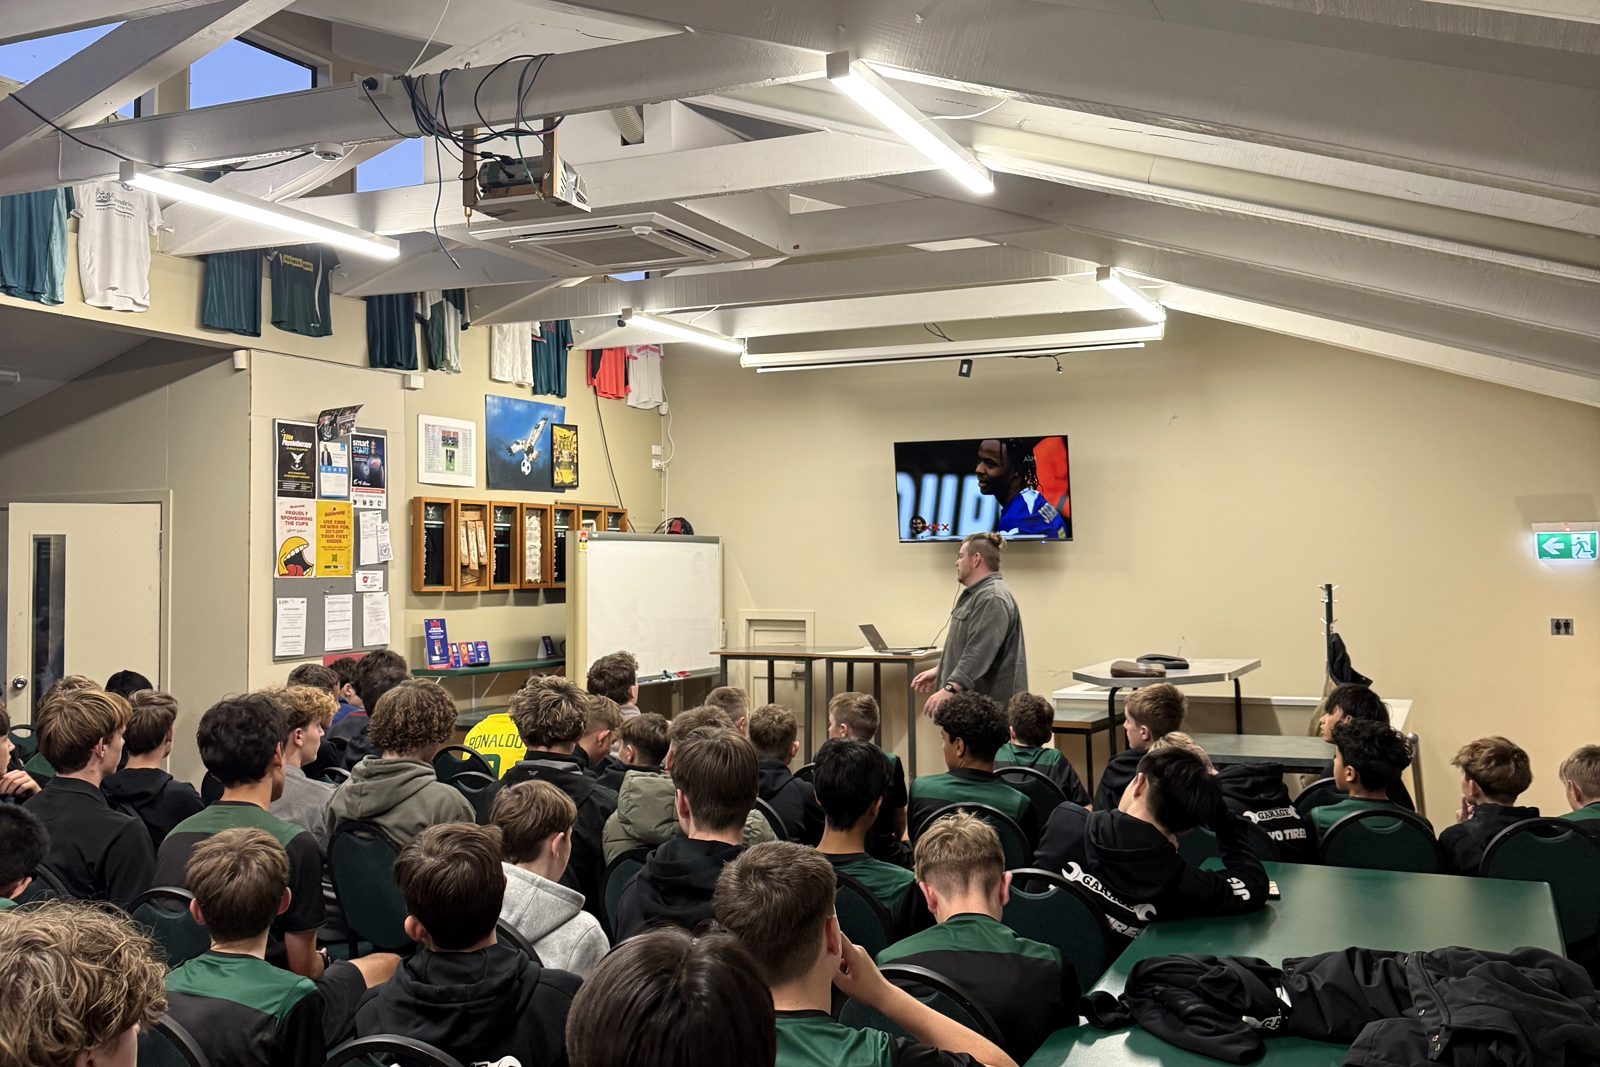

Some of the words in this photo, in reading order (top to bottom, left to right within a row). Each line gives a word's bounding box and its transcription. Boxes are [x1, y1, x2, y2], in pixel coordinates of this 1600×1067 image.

[352, 439, 369, 448] smart
[352, 446, 369, 455] START
[468, 733, 523, 749] RONALDO
[1257, 807, 1291, 820] GARAGE
